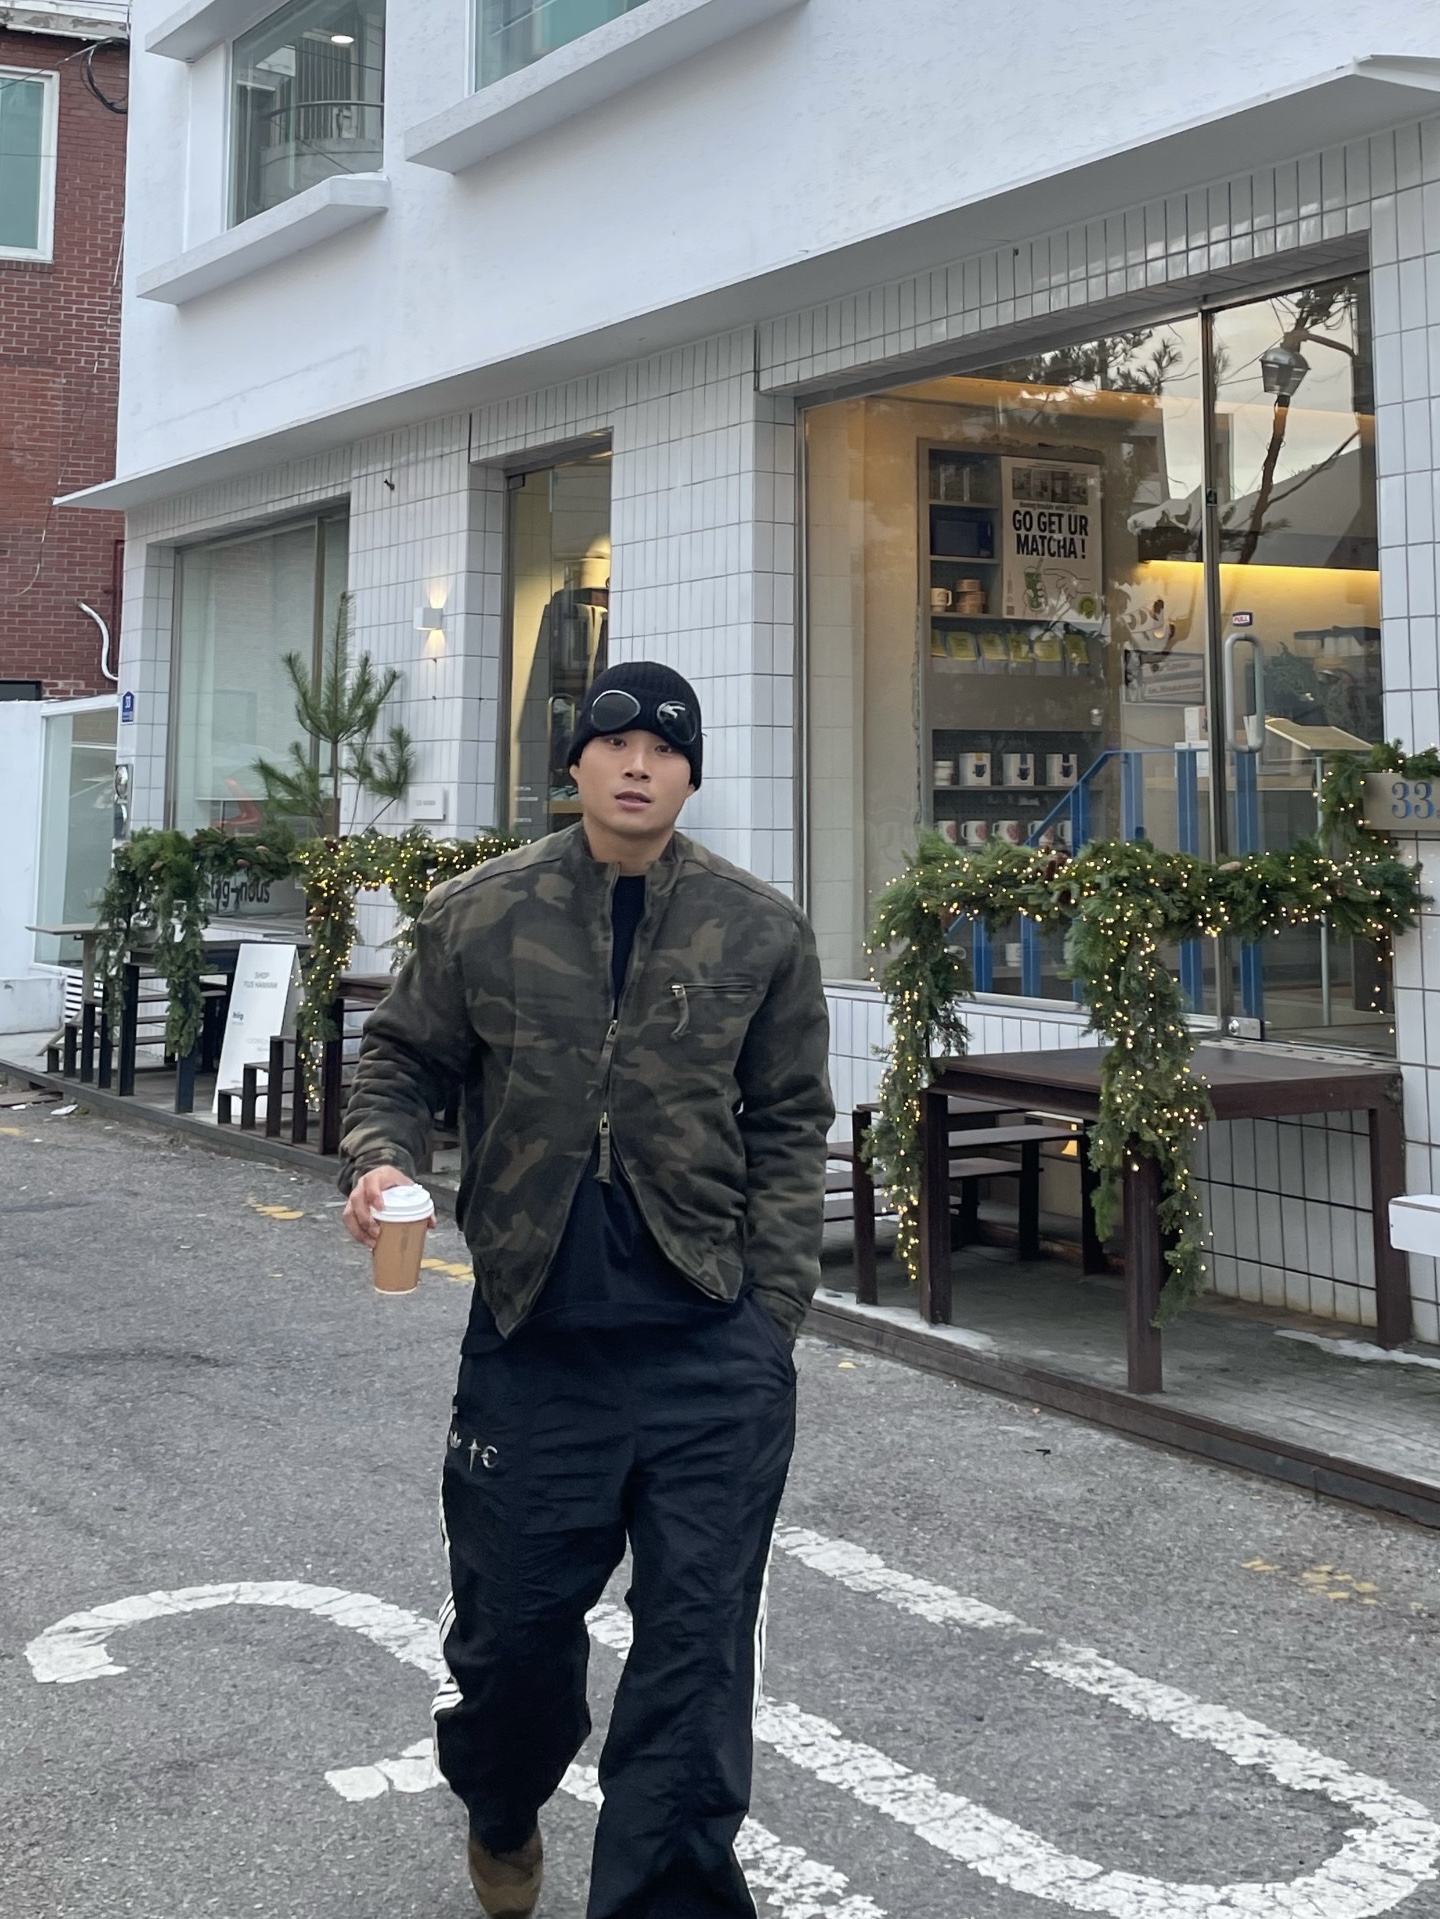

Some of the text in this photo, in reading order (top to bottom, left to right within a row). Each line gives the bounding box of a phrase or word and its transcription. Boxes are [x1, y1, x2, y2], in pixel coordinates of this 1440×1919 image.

[1012, 509, 1089, 536] GO GET UR
